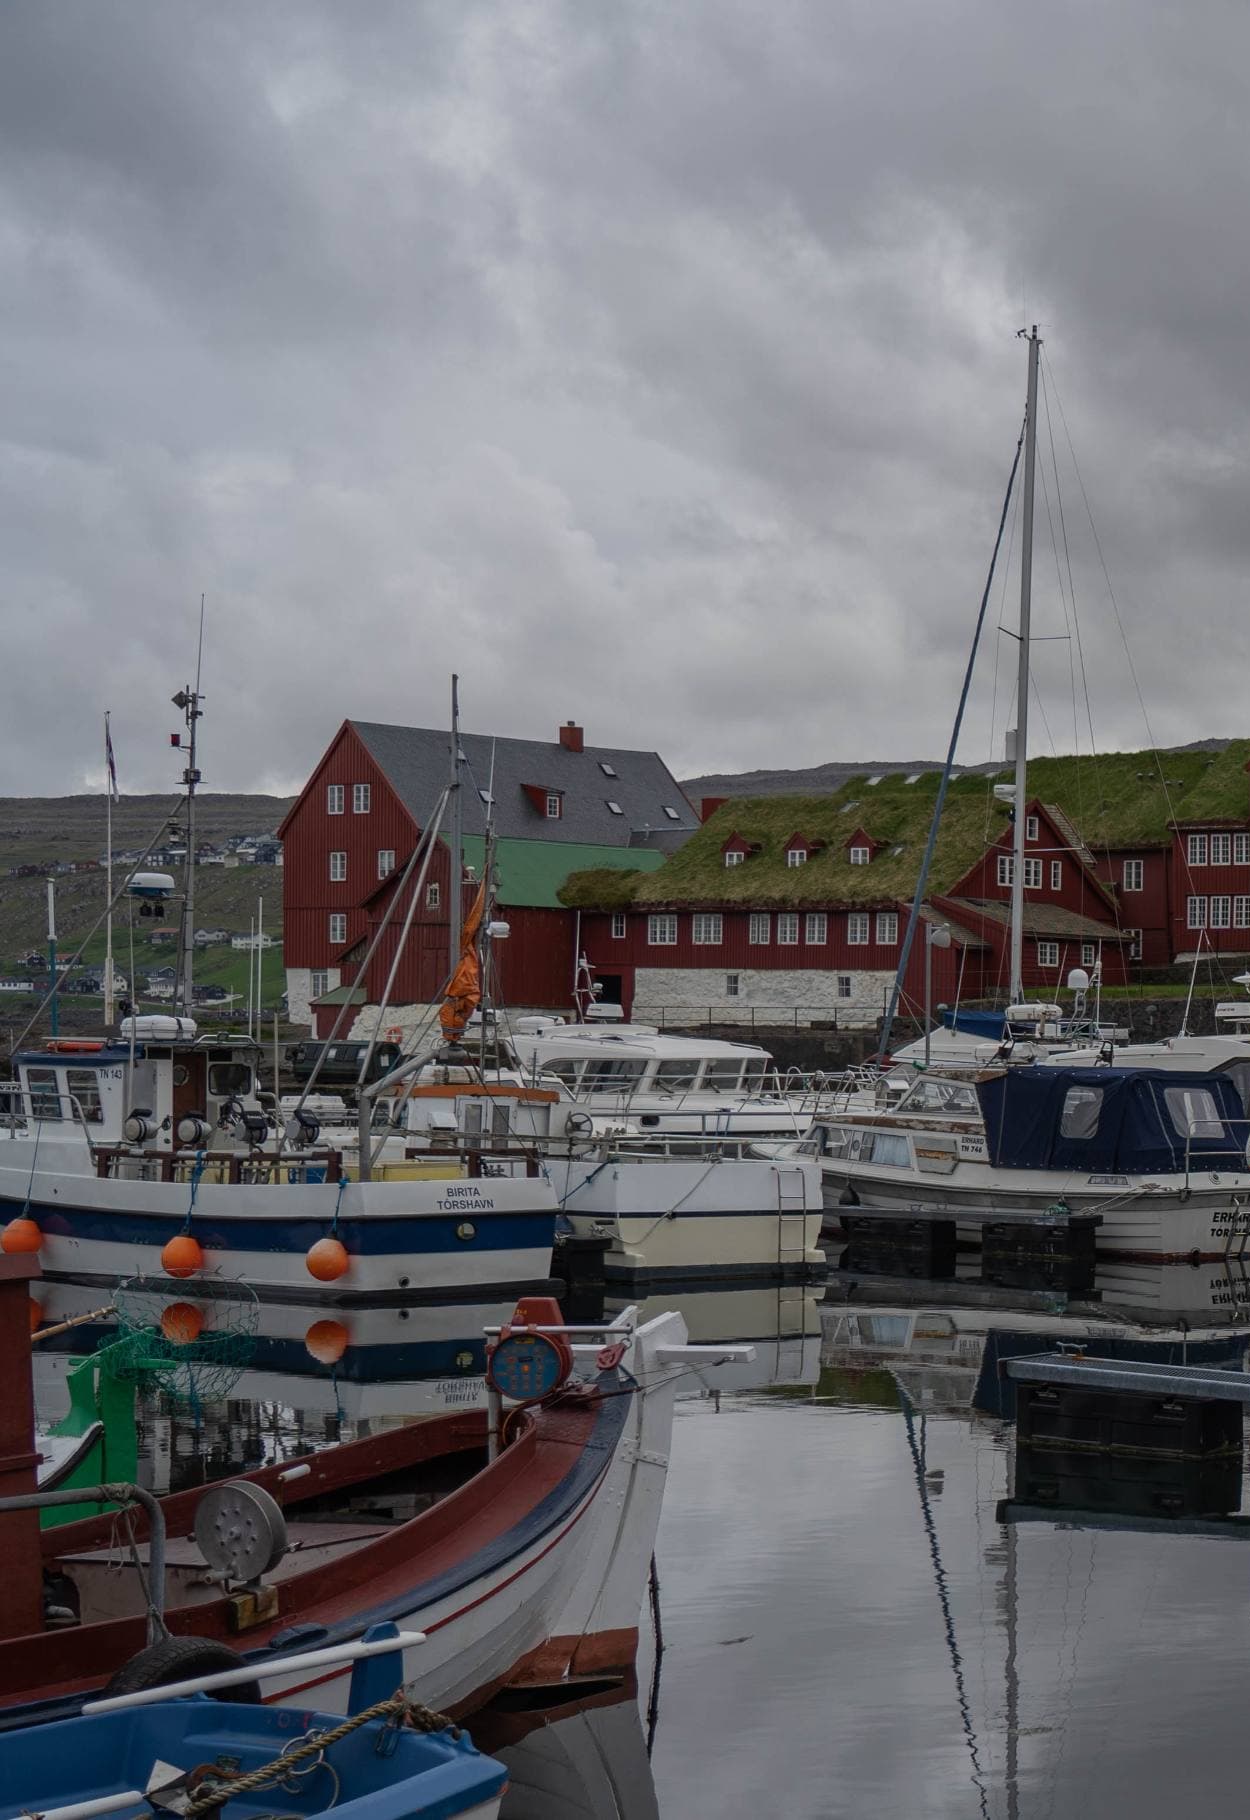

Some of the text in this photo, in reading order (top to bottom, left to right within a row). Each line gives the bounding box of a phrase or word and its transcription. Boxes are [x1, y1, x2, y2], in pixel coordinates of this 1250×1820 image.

[99, 1069, 109, 1079] TN
[962, 1145, 970, 1153] TN
[447, 1187, 481, 1198] BIRITA
[437, 1198, 494, 1210] TÓRSHAVN
